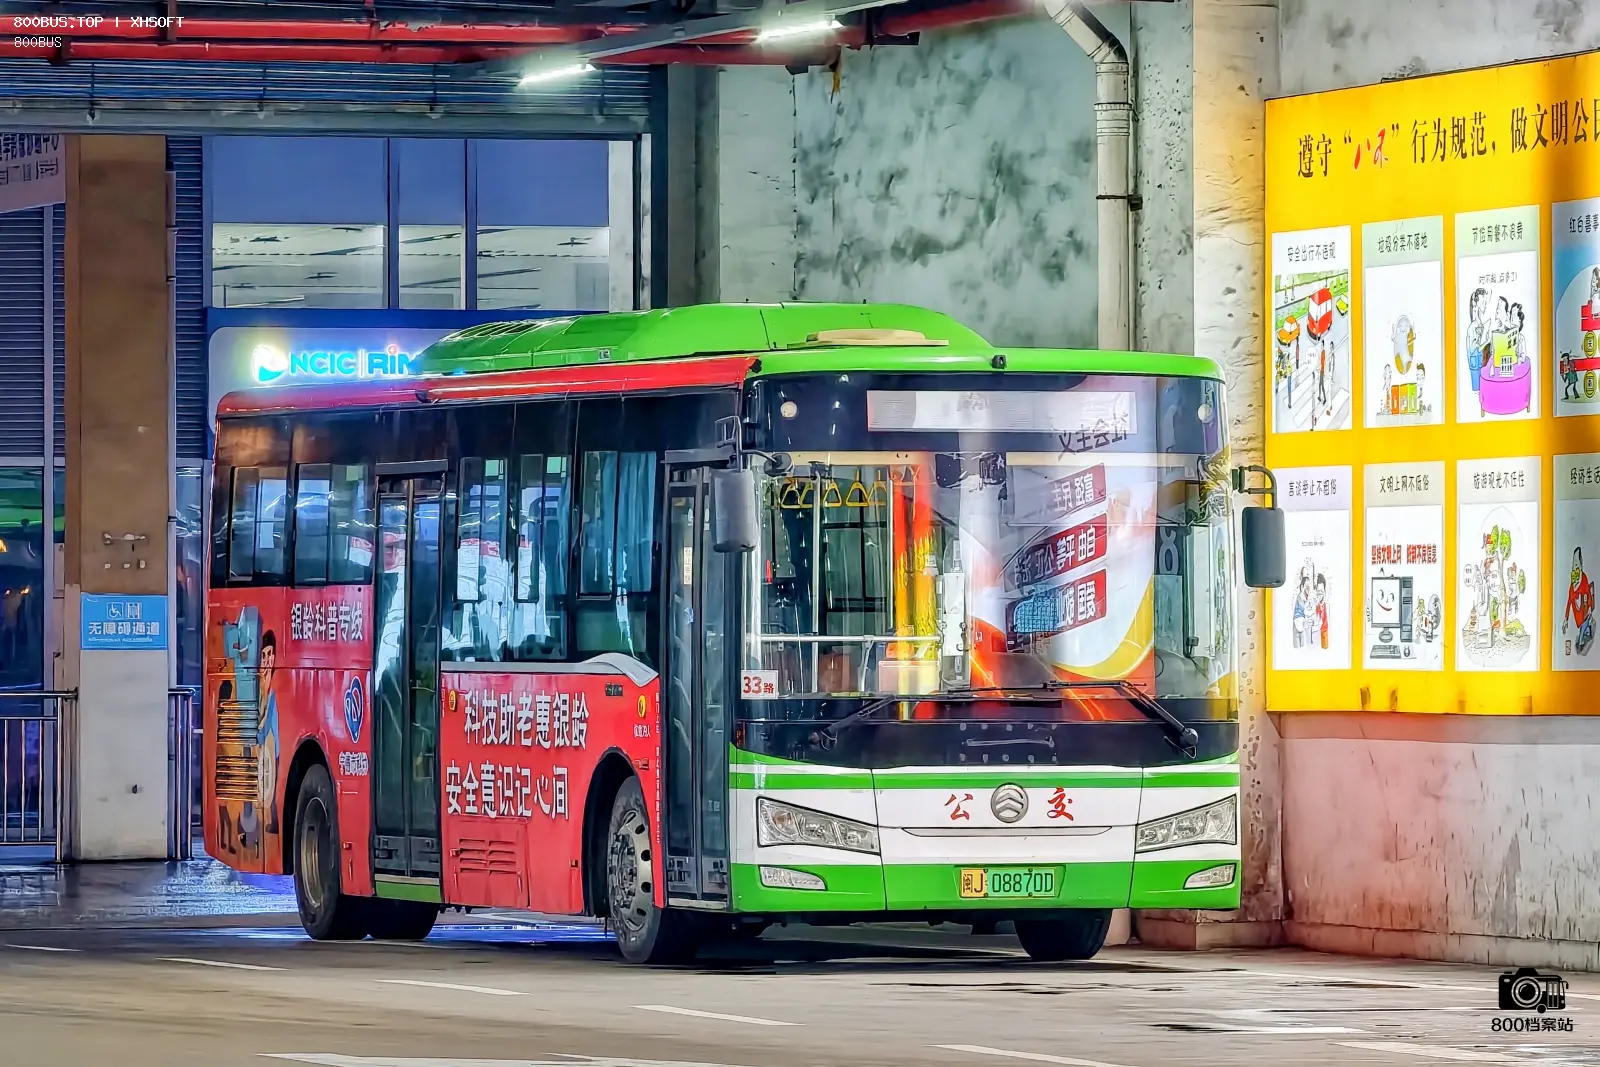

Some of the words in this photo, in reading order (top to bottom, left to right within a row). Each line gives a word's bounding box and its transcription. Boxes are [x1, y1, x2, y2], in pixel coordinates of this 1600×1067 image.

[1286, 241, 1336, 262] 安全出行不违规
[1377, 231, 1428, 253] 垃圾分类不落地
[289, 351, 356, 374] NCIC
[464, 688, 590, 750] 科技助老惠银龄
[445, 759, 569, 820] 安全意识记心间
